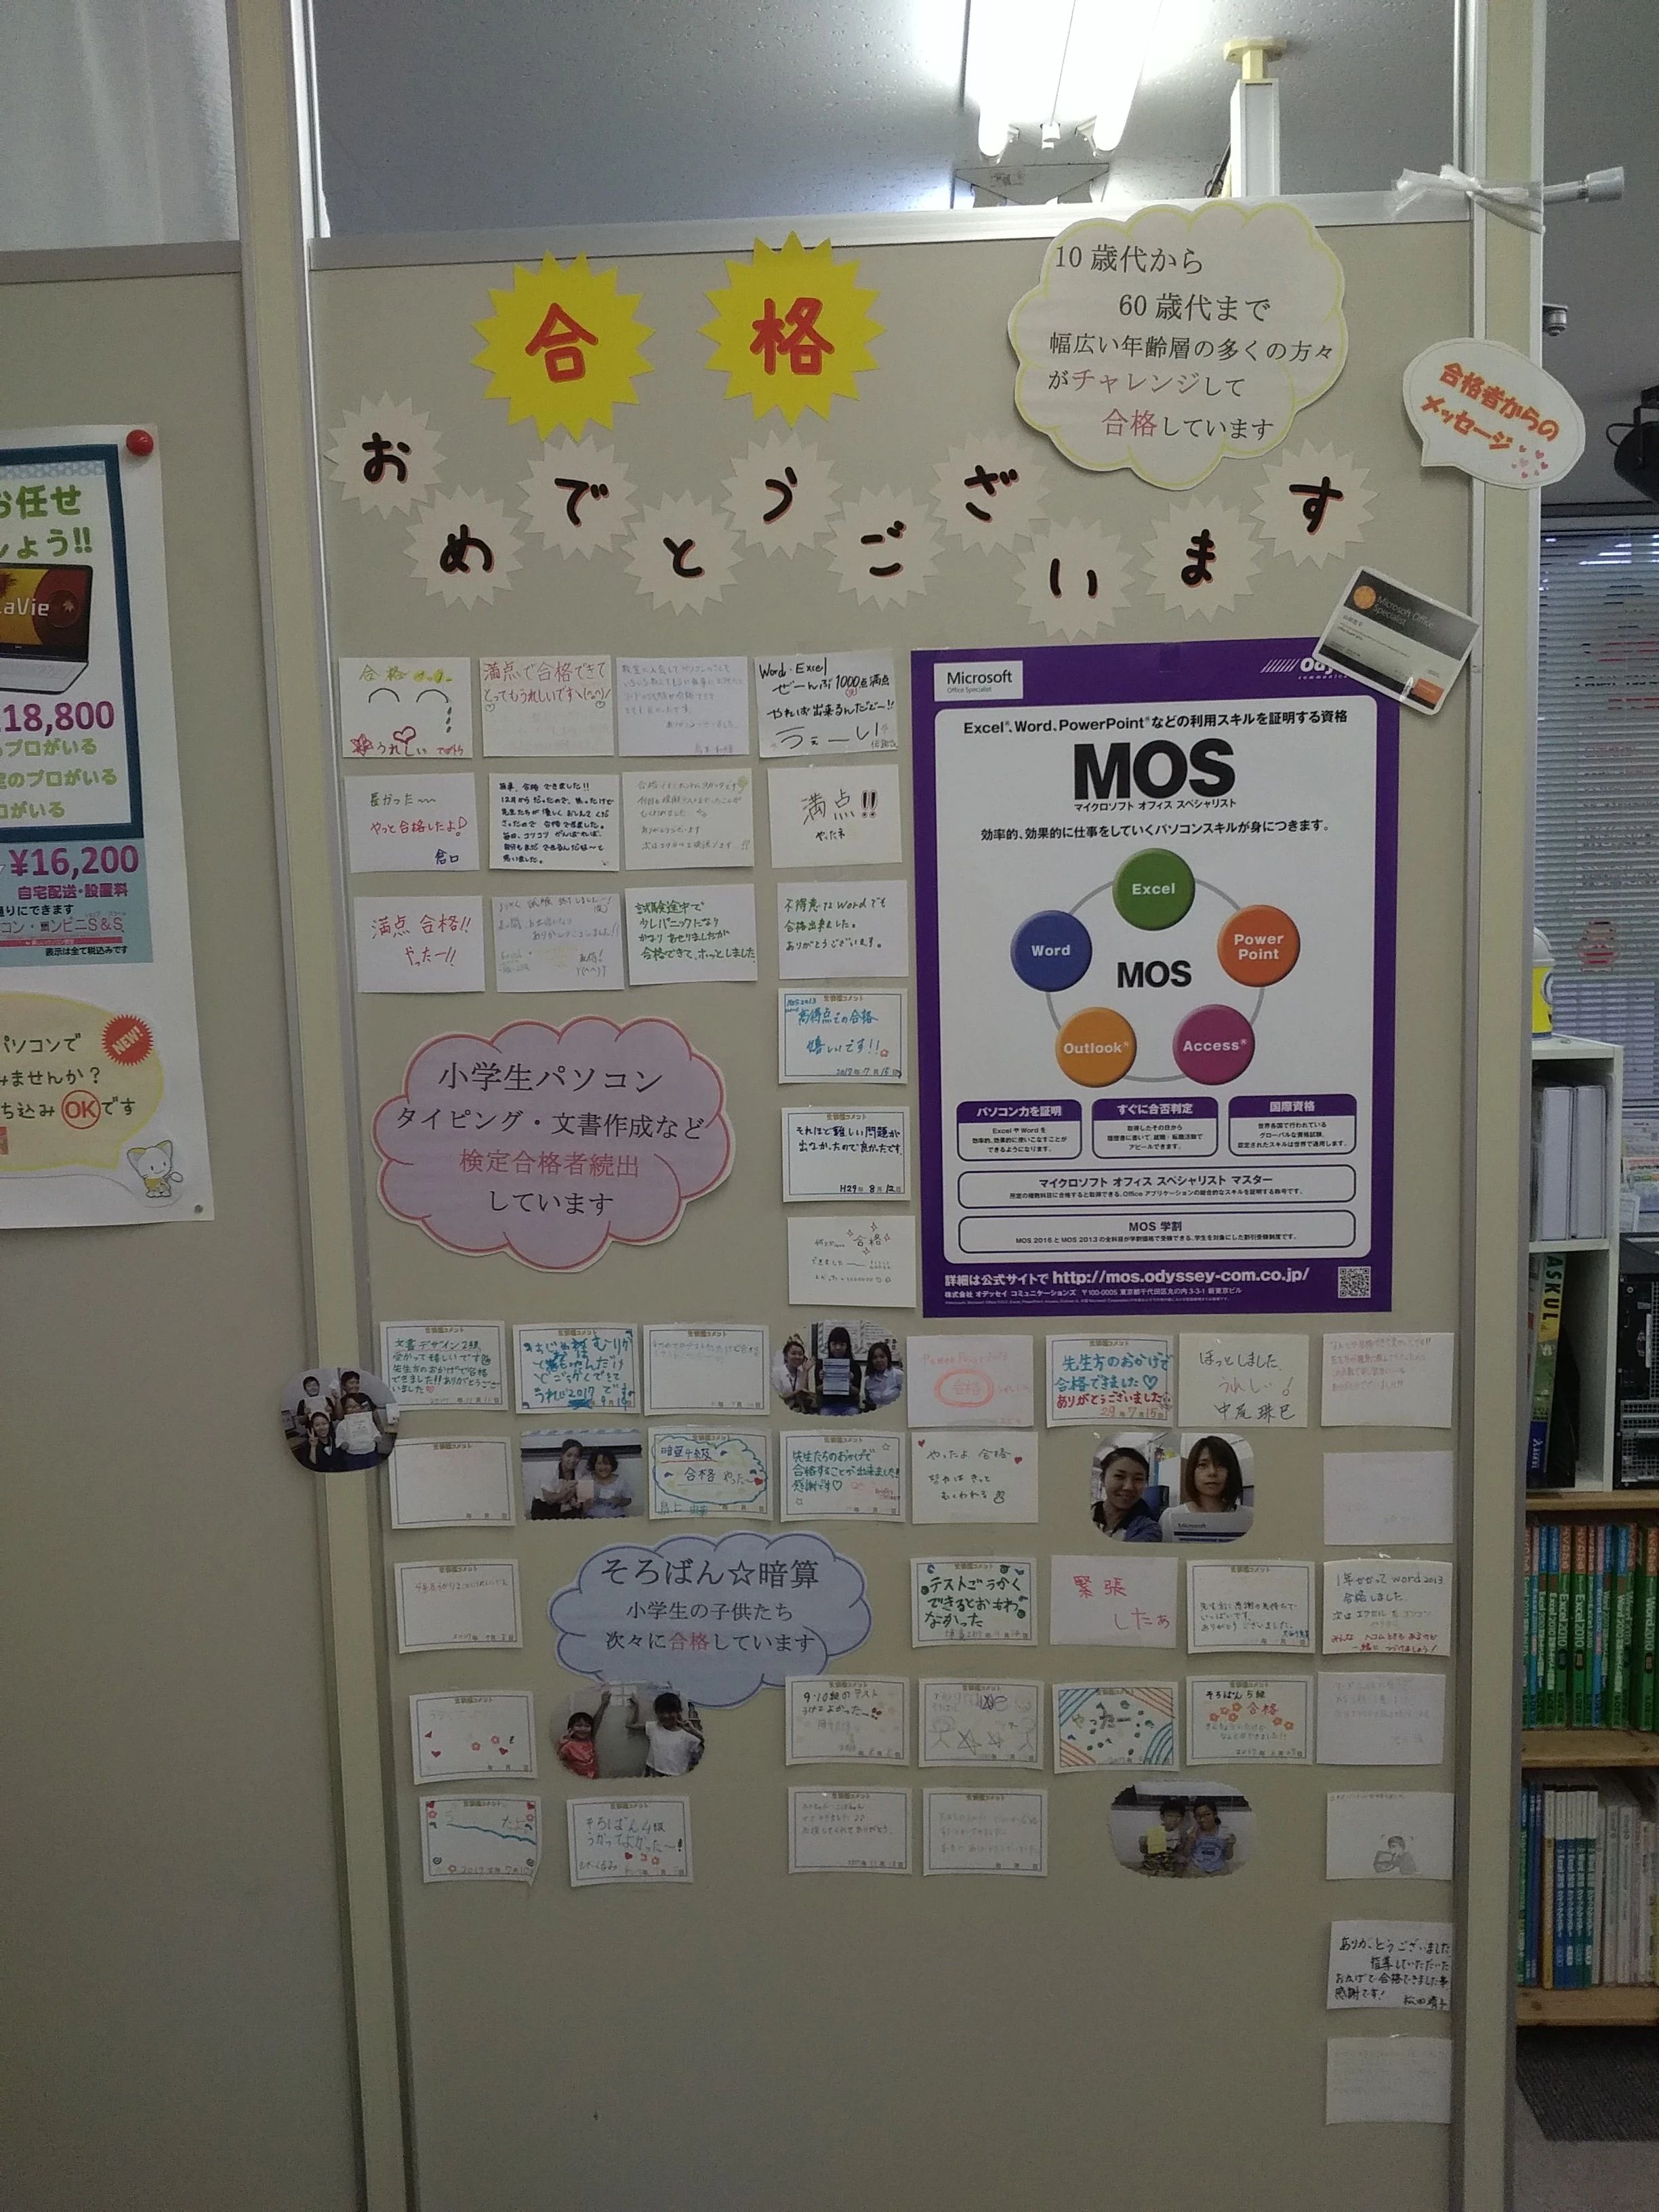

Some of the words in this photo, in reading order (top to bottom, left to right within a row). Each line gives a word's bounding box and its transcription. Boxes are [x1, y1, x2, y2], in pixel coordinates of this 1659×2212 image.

[1049, 332, 1334, 363] 幅広い年齢層の多くの方々
[1048, 368, 1244, 398] がチャレンジして
[1440, 362, 1559, 442] 合格者からの
[1103, 408, 1274, 442] 合格しています
[1421, 394, 1513, 451] メッセージ
[947, 670, 1013, 685] Microsoft
[0, 701, 115, 737] 18,800
[1074, 738, 1235, 800] MOS
[1074, 802, 1134, 813] マイクロソフト
[1138, 800, 1172, 811] オフィス
[1176, 798, 1236, 810] スペシャリスト
[9, 844, 140, 880] ¥16,200
[1131, 882, 1176, 896] Excel
[1031, 944, 1071, 958] Word
[1233, 933, 1284, 946] Power
[1237, 947, 1279, 961] Point
[1117, 960, 1192, 989] MOS
[438, 1061, 663, 1094] 小学生パソコン
[977, 1105, 1063, 1118] パソコン力を証明
[1117, 1103, 1193, 1115] すぐに合否判定
[1269, 1101, 1315, 1113] 国際資格
[396, 1107, 705, 1140] タイピング・文書作成など
[459, 1147, 639, 1179] 検定合格者続出
[1231, 1175, 1273, 1185] マスター
[489, 1189, 614, 1217] しています
[1160, 1221, 1183, 1231] 学割
[944, 1273, 1048, 1287] 詳細は公式サイトで
[1052, 1267, 1310, 1286] http://mos.odyssey-com.co.jp/
[1542, 1254, 1564, 1322] ASKUL
[627, 1600, 793, 1622] 小学生の子供たち
[607, 1630, 815, 1654] 次々に合格しています
